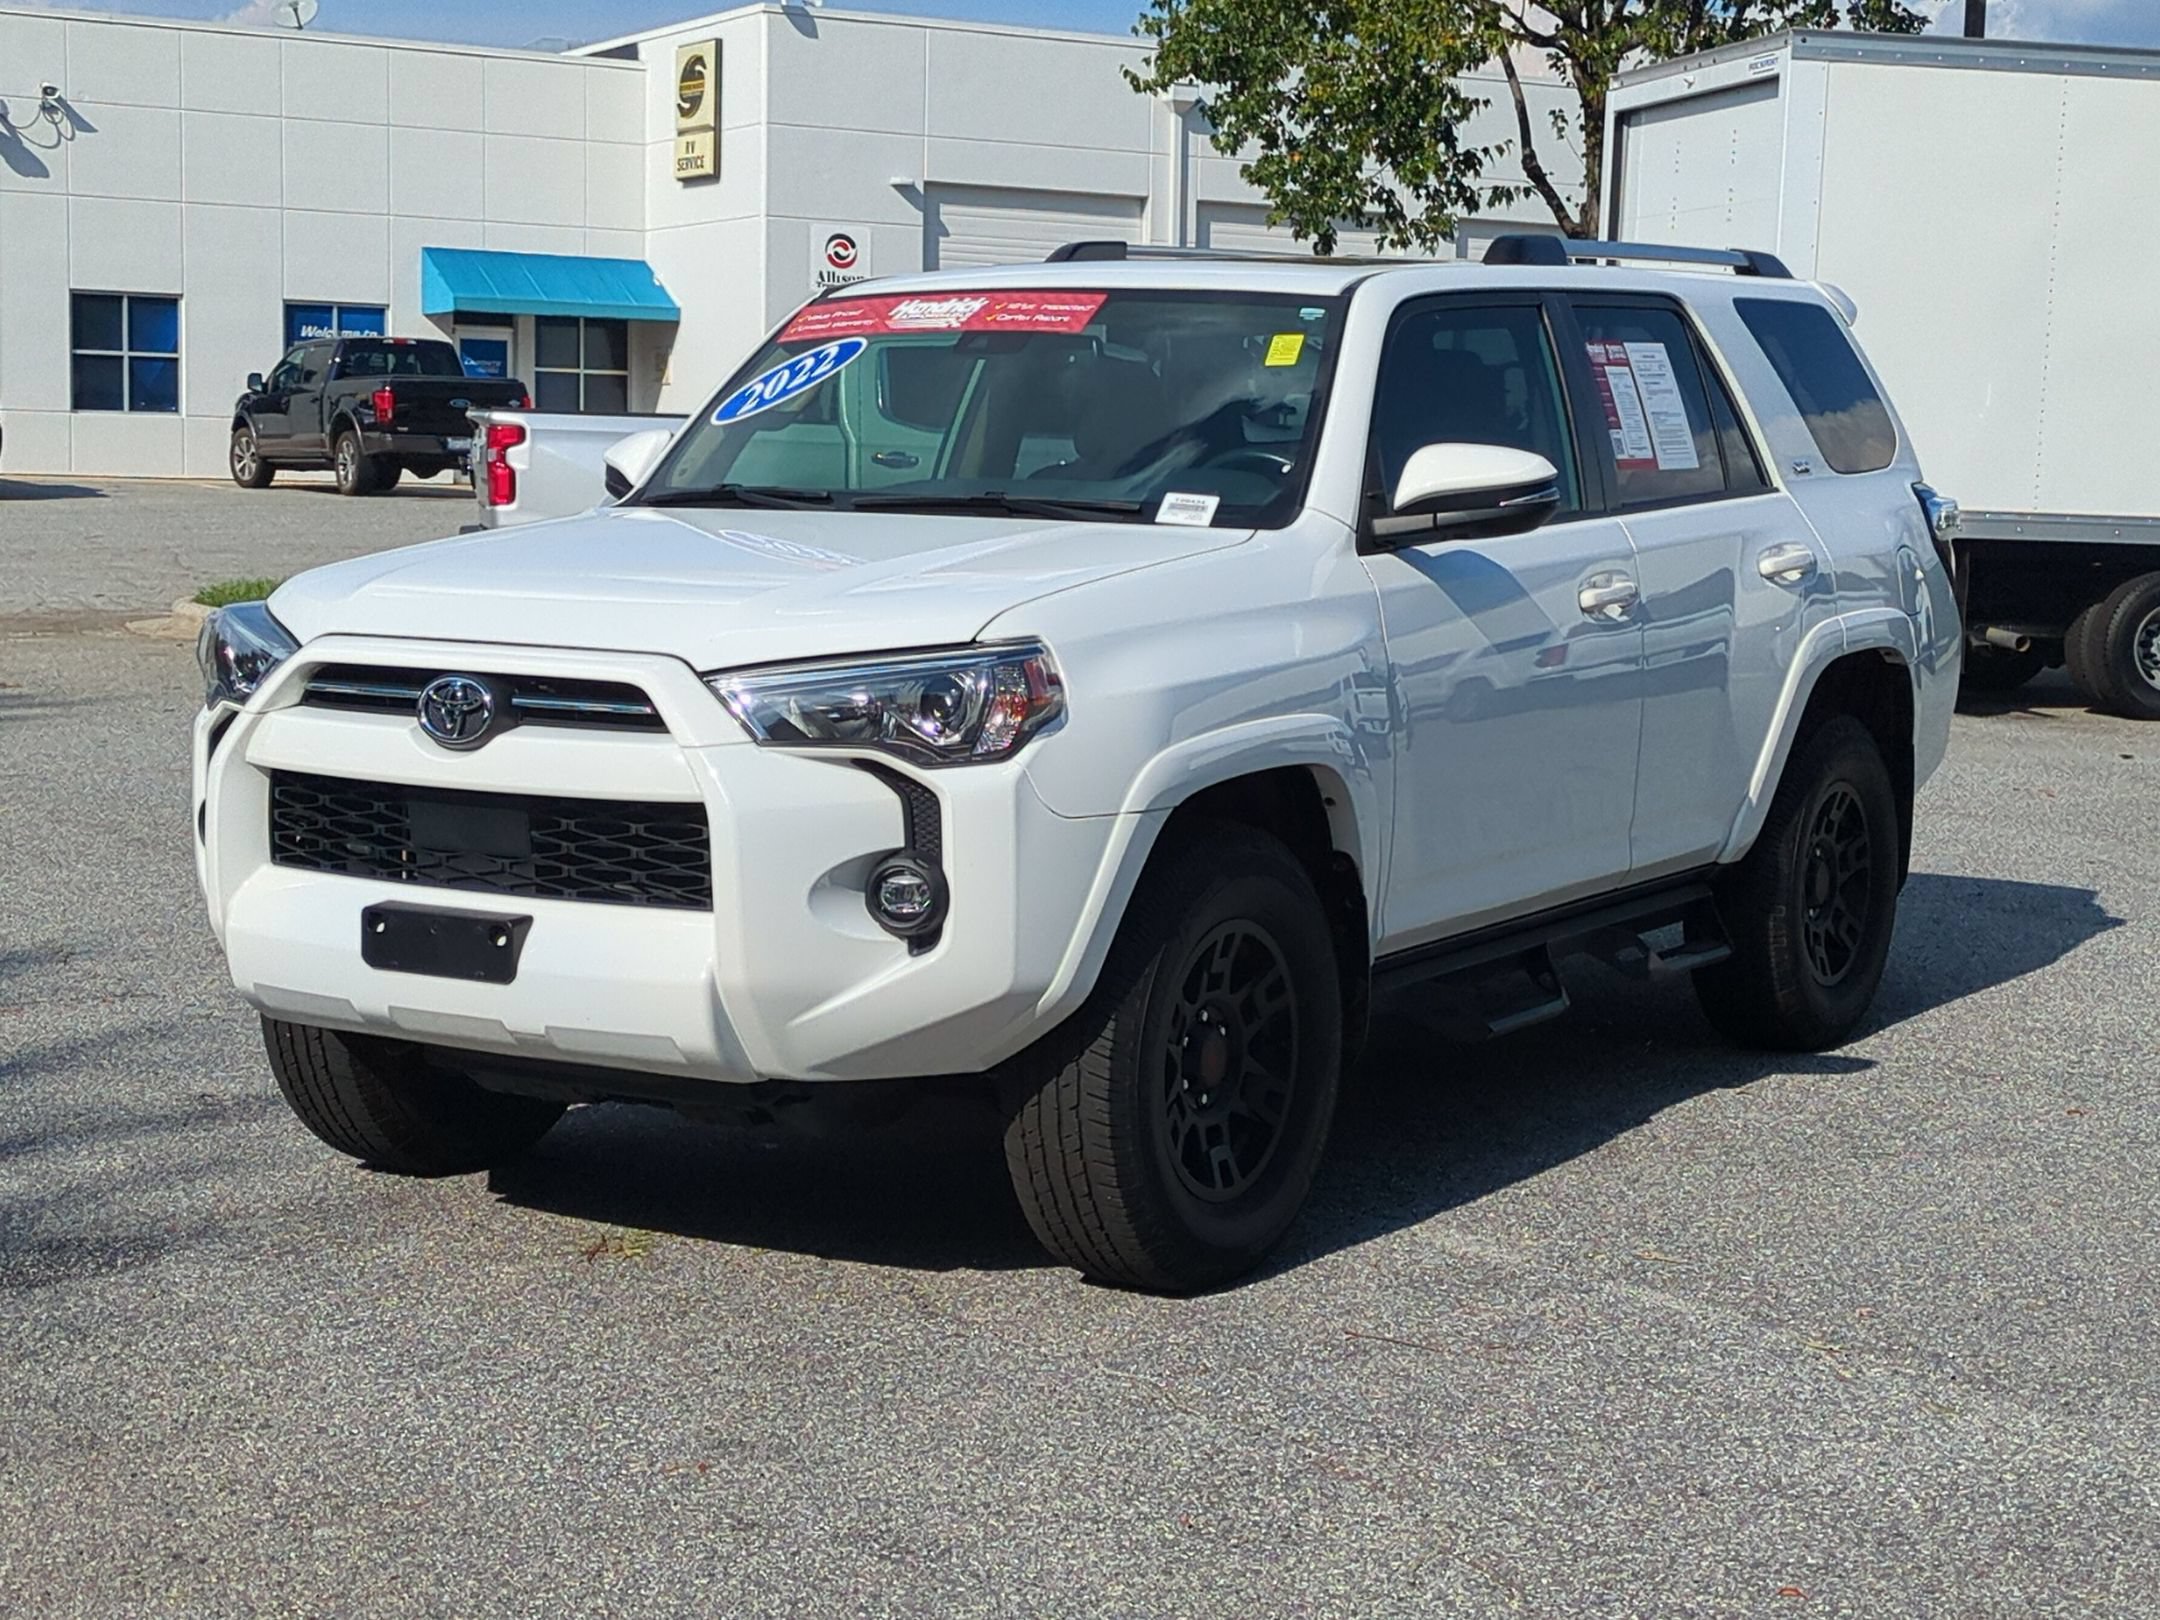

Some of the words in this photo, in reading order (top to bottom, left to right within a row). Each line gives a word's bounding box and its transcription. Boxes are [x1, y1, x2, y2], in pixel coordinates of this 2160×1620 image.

[677, 155, 704, 172] SERVICE
[888, 296, 990, 322] Hendrick
[736, 345, 839, 416] 2022
